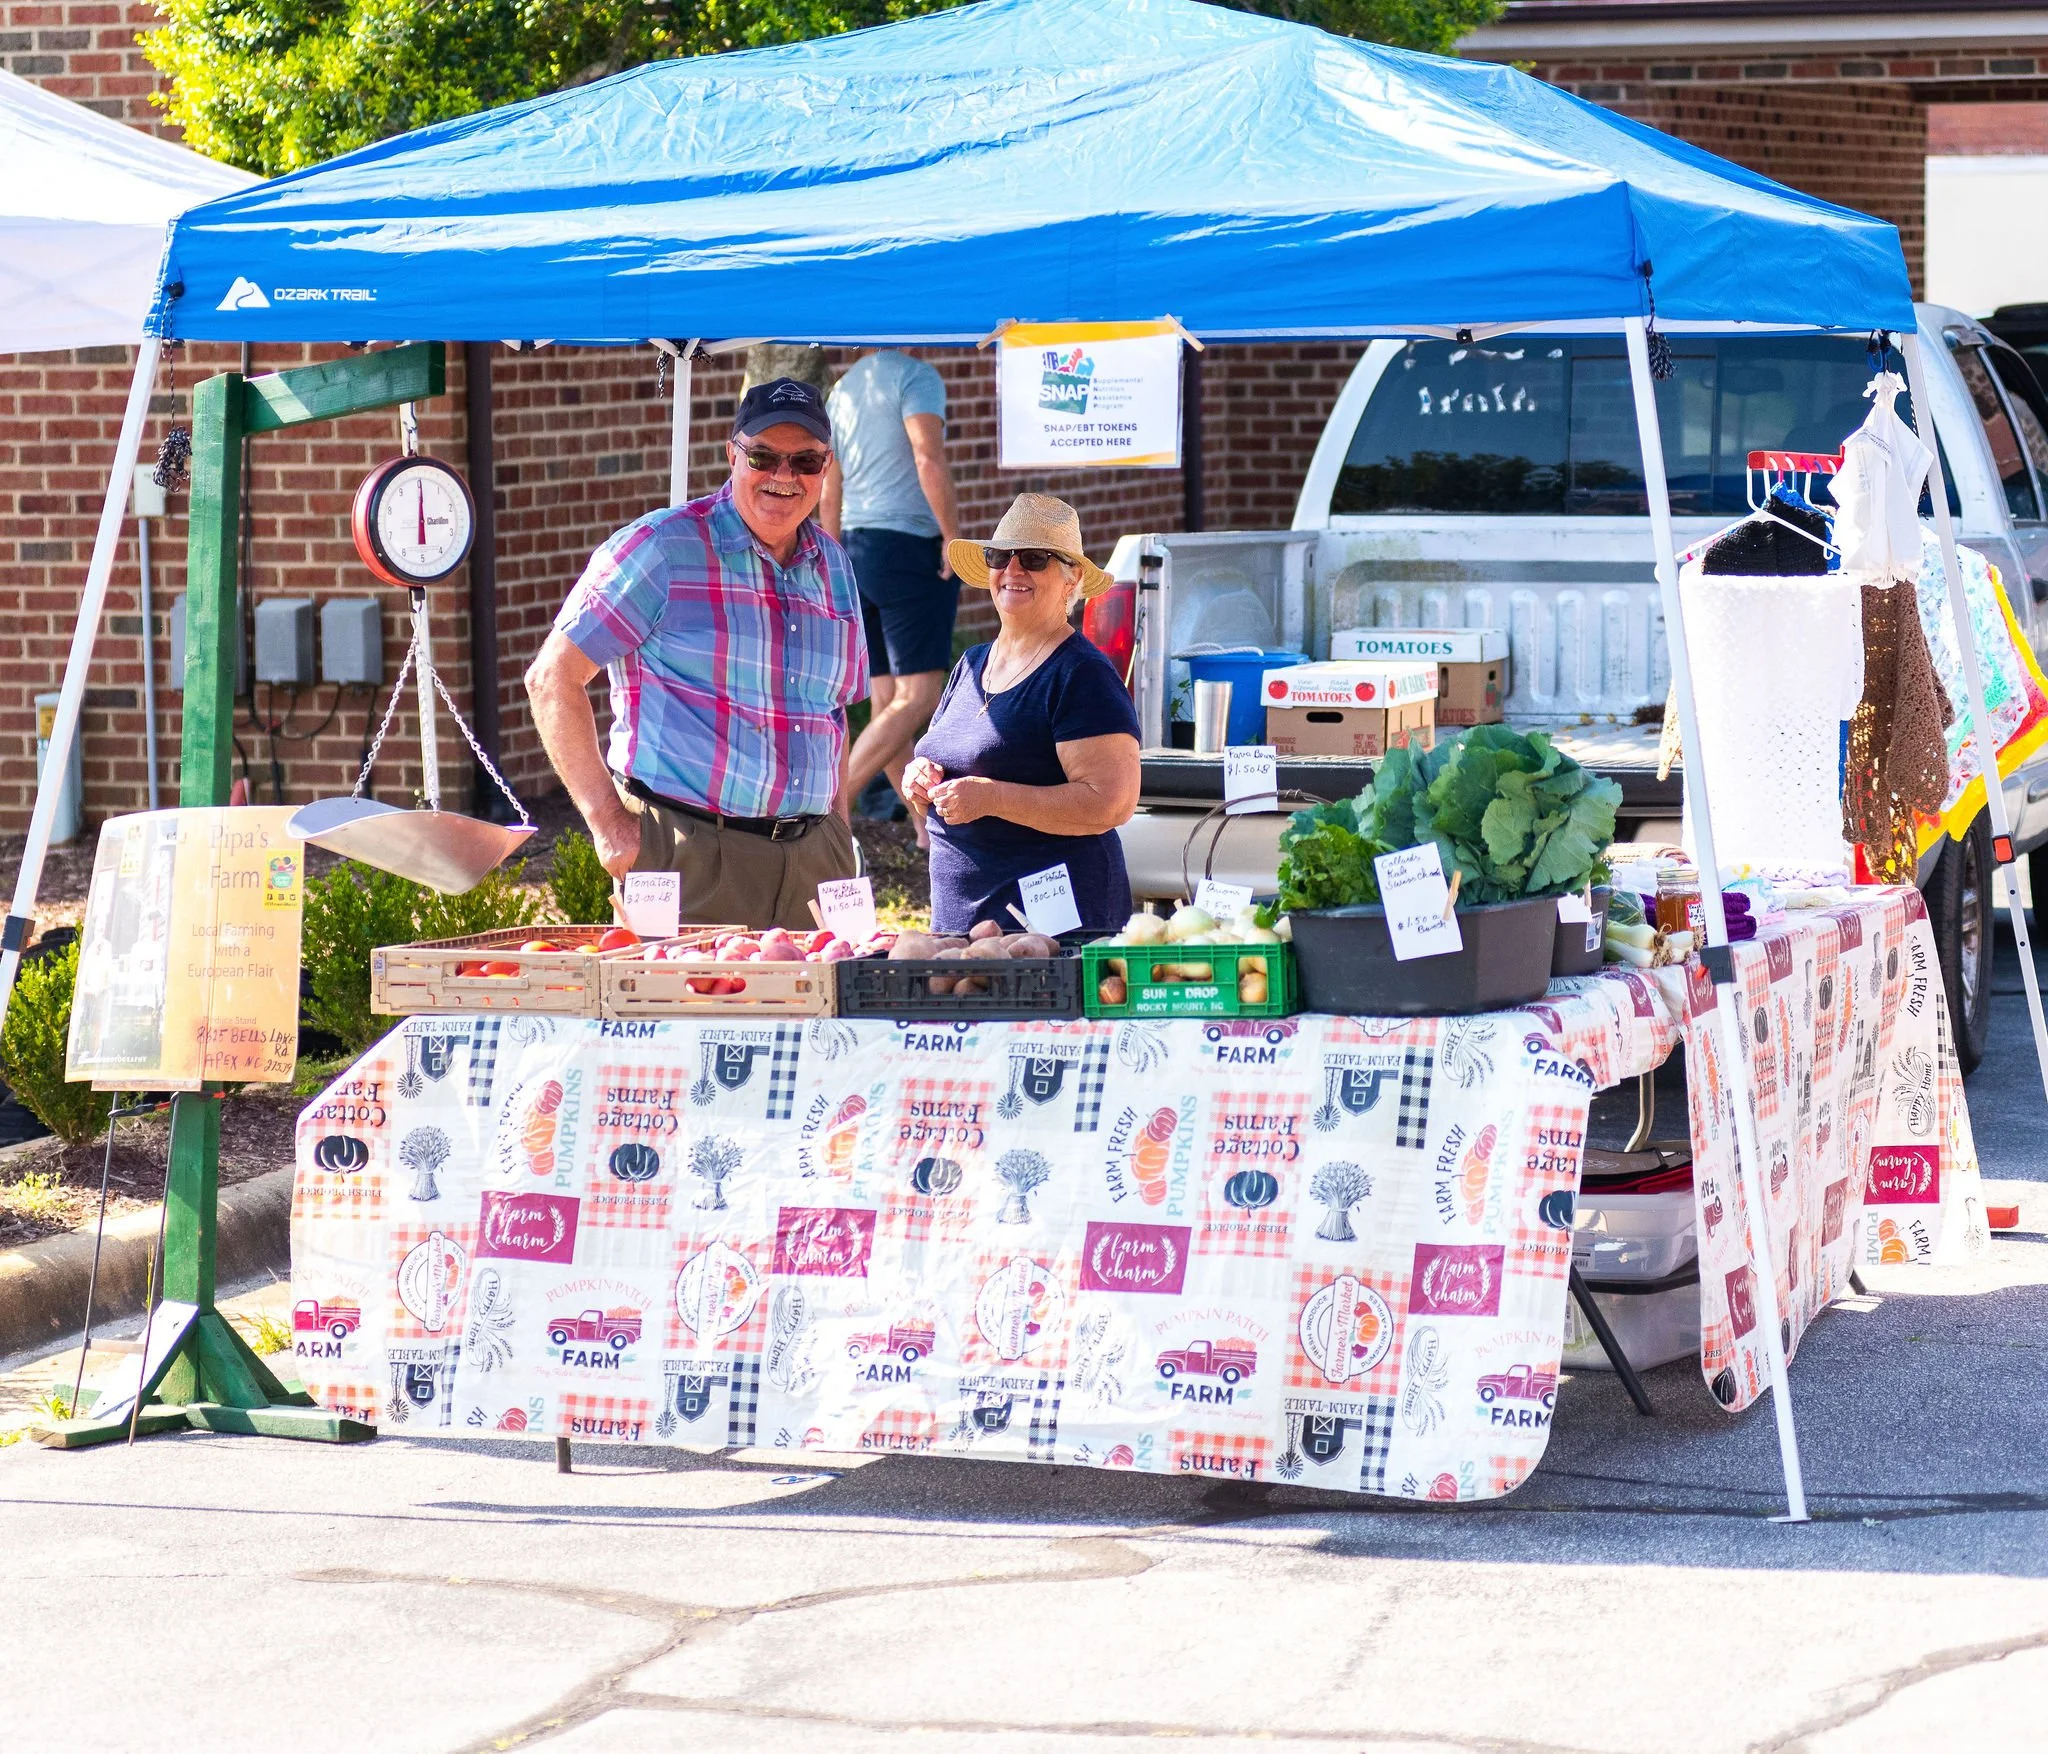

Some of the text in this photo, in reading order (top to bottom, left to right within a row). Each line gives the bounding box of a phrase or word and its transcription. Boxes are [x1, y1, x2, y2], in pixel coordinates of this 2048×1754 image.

[274, 288, 372, 301] OZARK TRAIL
[1039, 384, 1090, 402] SNAP
[1093, 402, 1124, 410] Program
[1044, 422, 1138, 433] SNAP/EBT TOKENS
[1050, 437, 1132, 447] ACCEPTED HERE
[1356, 640, 1453, 654] TOMATOES
[1291, 691, 1352, 703] TOMATOES
[1271, 736, 1296, 745] PRODUCE
[1228, 763, 1270, 776] $1.50 LB
[210, 824, 269, 856] Pipa's
[210, 865, 260, 889] Farm
[658, 892, 673, 902] LB
[853, 897, 864, 907] LB
[1053, 885, 1066, 897] LB
[192, 923, 275, 939] Local Farming
[215, 943, 251, 957] with a
[188, 963, 274, 981] European Flair
[1142, 986, 1219, 1000] SUN DROP
[1905, 976, 1929, 1019] FRESH
[1136, 1002, 1168, 1012] ROCKY
[1210, 1002, 1224, 1010] NC
[235, 1017, 257, 1025] Stand
[600, 1022, 655, 1039] FARM
[230, 1027, 267, 1043] BELLS
[269, 1028, 296, 1045] LAKE
[699, 1030, 773, 1043] FARM TABLE
[904, 1033, 963, 1052] FARM
[205, 1051, 239, 1070] APEX
[245, 1056, 261, 1069] NC
[1216, 1045, 1276, 1065] FARM
[1323, 1053, 1402, 1067] FARM TABLE
[1533, 1058, 1594, 1089] FARM
[607, 1087, 676, 1111] Farms
[1910, 1062, 1933, 1127] Happy Home
[598, 1106, 679, 1136] Cottage
[801, 1094, 831, 1140] FRESH
[910, 1101, 982, 1124] Farms
[555, 1068, 583, 1189] PUMPKINS
[1224, 1114, 1298, 1136] Farms
[1104, 1106, 1139, 1203] FARM FRESH
[1165, 1094, 1198, 1218] PUMPKINS
[1214, 1138, 1300, 1162] Cottage
[1435, 1123, 1468, 1225] FARM FRESH
[1876, 1153, 1918, 1178] charm
[1879, 1174, 1918, 1196] farm
[498, 1201, 546, 1227] farm
[495, 1219, 549, 1249] charm
[1254, 1224, 1289, 1234] FRESH
[1908, 1218, 1932, 1257] FARM
[1110, 1231, 1158, 1259] farm
[1106, 1256, 1160, 1284] charm
[1440, 1255, 1477, 1276] farm
[545, 1278, 609, 1304] PUMPKIN
[612, 1280, 654, 1311] PATCH
[1434, 1273, 1481, 1304] charm
[1154, 1304, 1270, 1342] PUMPKIN PATCH
[1306, 1294, 1328, 1360] FRESH PRODUCE
[1331, 1280, 1354, 1379] Farmer's Market
[1360, 1293, 1388, 1369] PUMPKINS APPLES
[294, 1341, 342, 1359] ARM
[387, 1348, 425, 1360] TABLE
[1474, 1330, 1542, 1358] PUMPKIN
[562, 1349, 620, 1370] FARM
[664, 1359, 696, 1371] TABLE
[770, 1339, 787, 1372] Home
[1404, 1337, 1438, 1417] Happy Home
[1170, 1383, 1235, 1405] FARM
[1284, 1398, 1364, 1415] FARM TABLE
[1491, 1407, 1550, 1428] FARM
[571, 1416, 643, 1441] Farms
[1180, 1453, 1261, 1478] Farms
